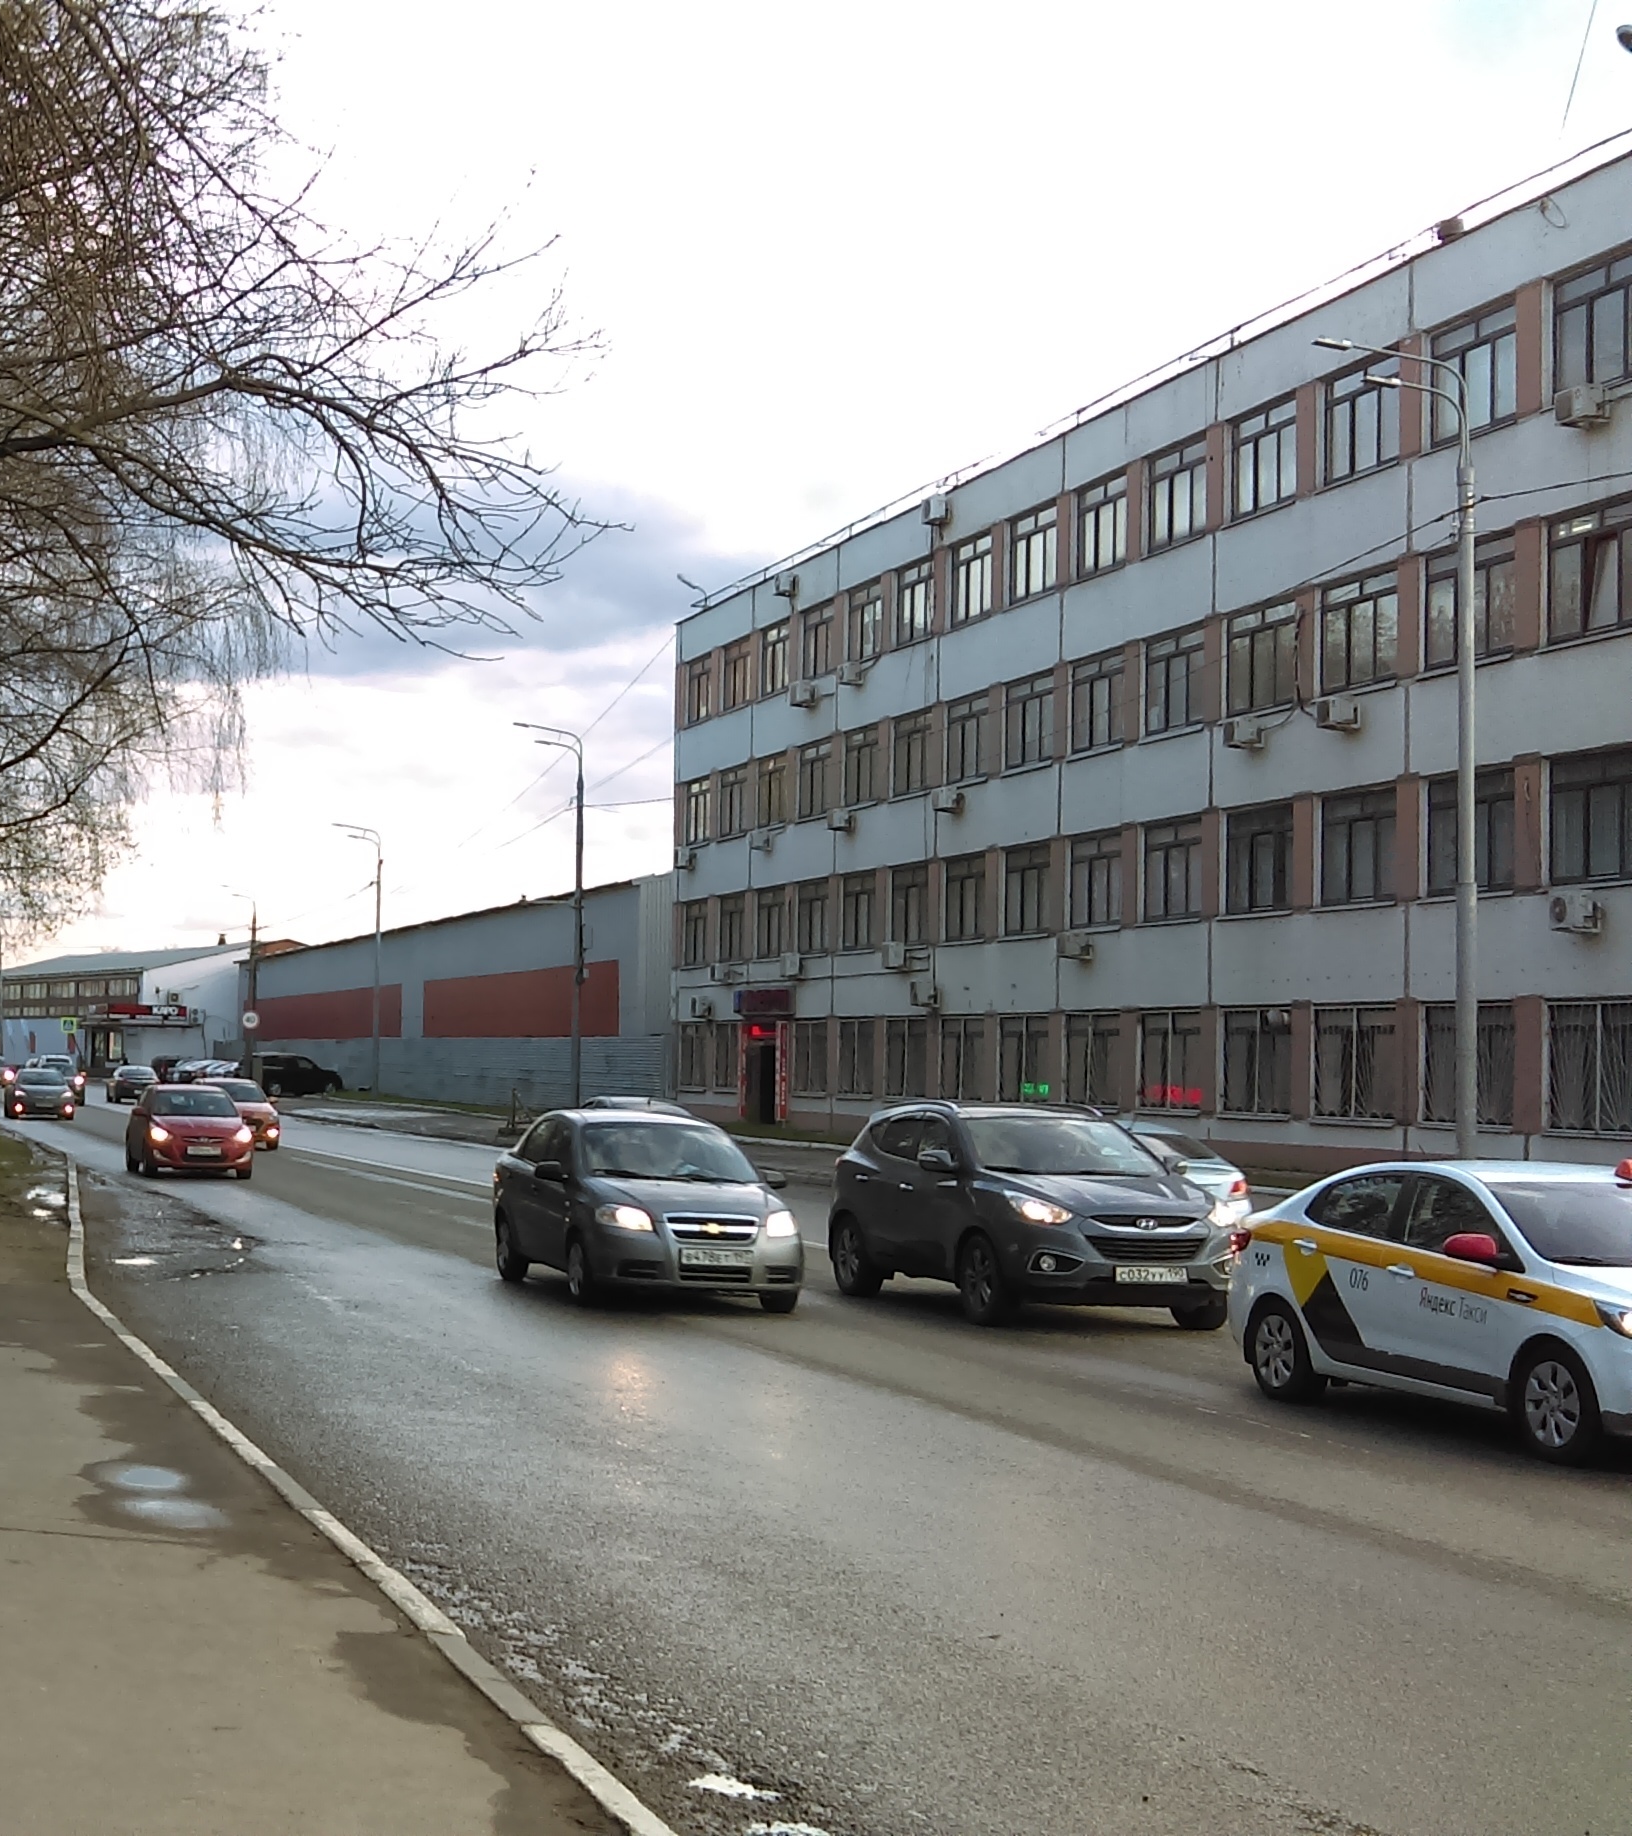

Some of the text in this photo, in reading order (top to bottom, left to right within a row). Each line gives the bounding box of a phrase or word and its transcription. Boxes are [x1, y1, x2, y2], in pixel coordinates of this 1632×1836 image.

[1349, 1267, 1370, 1292] 076
[1419, 1286, 1488, 1325] Яндекс Такси
